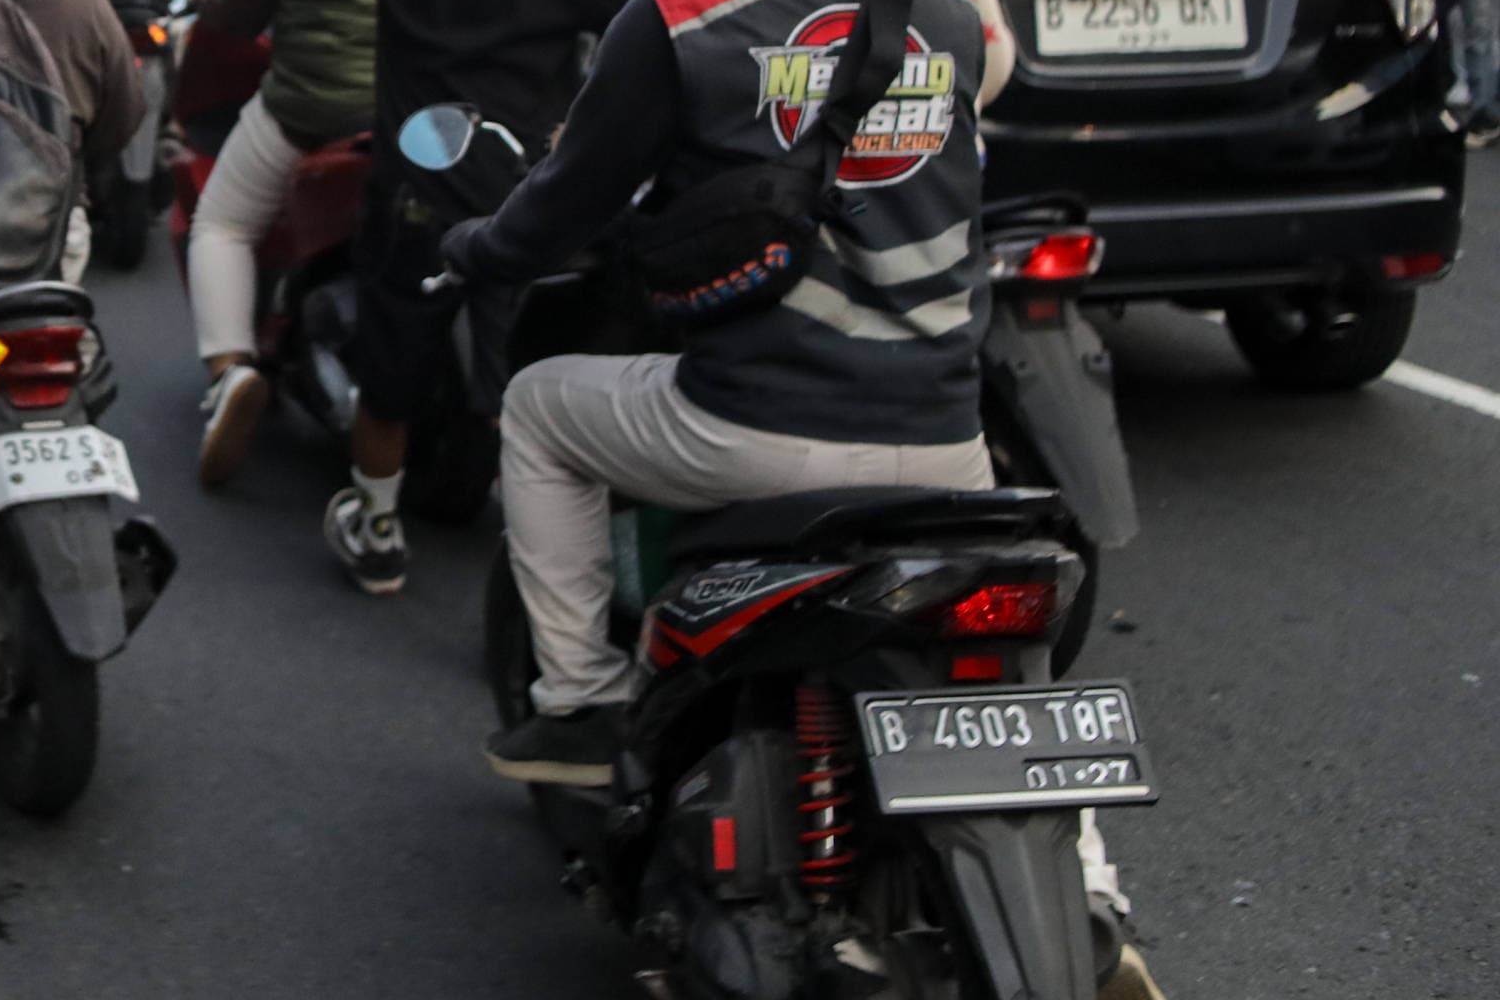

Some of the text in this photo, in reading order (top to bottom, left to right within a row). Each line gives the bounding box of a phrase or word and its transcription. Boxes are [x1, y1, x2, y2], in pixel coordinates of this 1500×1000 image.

[4, 436, 71, 466] 3562
[879, 710, 908, 752] B
[933, 704, 1033, 749] 4603
